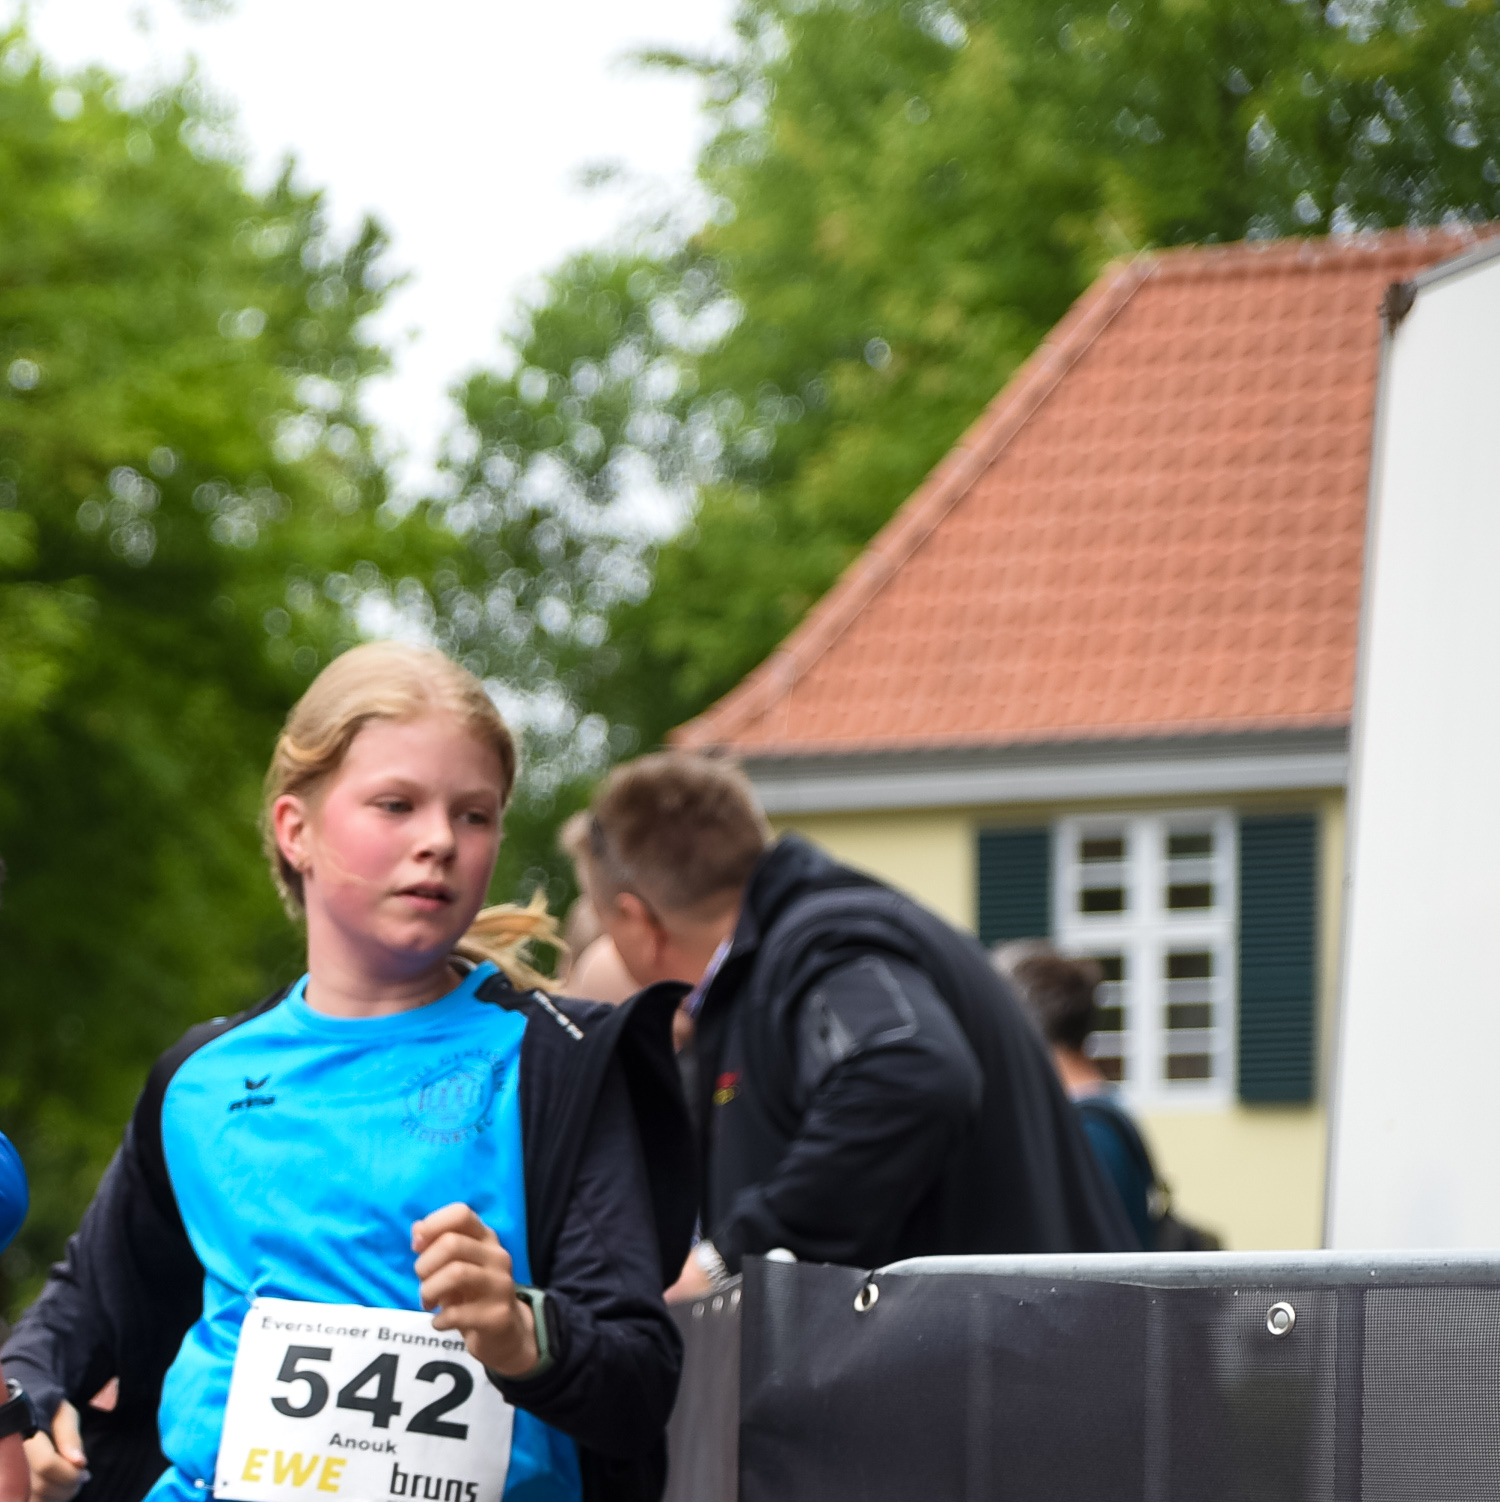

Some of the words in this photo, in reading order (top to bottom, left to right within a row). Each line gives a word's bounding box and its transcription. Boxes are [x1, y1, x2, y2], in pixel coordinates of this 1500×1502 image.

[260, 1315, 371, 1340] Everstener
[376, 1327, 467, 1352] Brunnen
[270, 1344, 474, 1441] 542
[328, 1432, 399, 1455] Anouk
[240, 1447, 348, 1494] EWE
